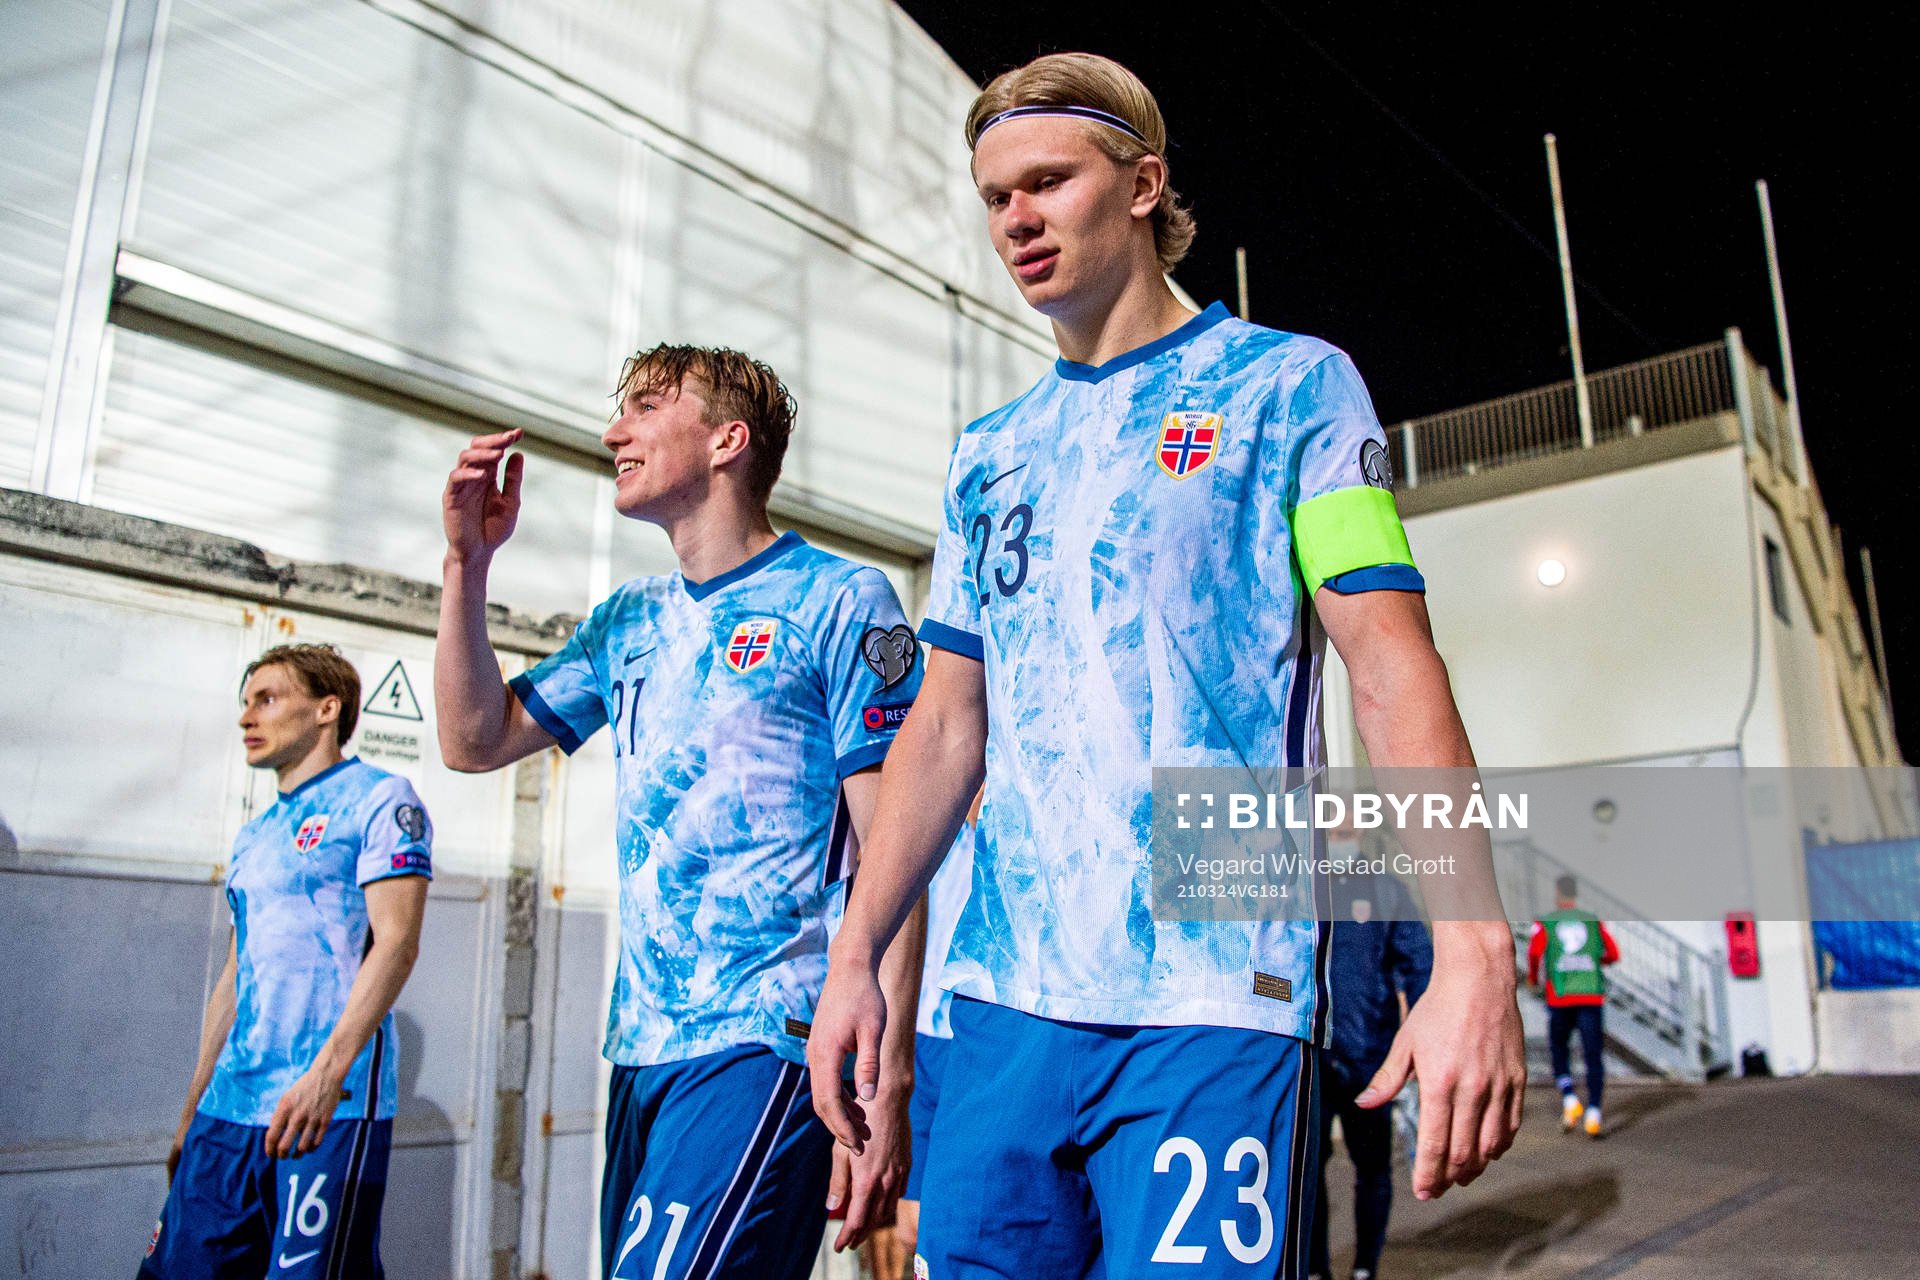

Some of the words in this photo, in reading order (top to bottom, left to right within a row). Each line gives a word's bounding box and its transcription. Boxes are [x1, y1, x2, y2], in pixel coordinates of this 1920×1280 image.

[972, 503, 1033, 608] 23
[364, 730, 417, 747] DANGER
[283, 1173, 329, 1237] 16
[612, 1194, 691, 1280] 21
[1150, 1136, 1274, 1264] 23
